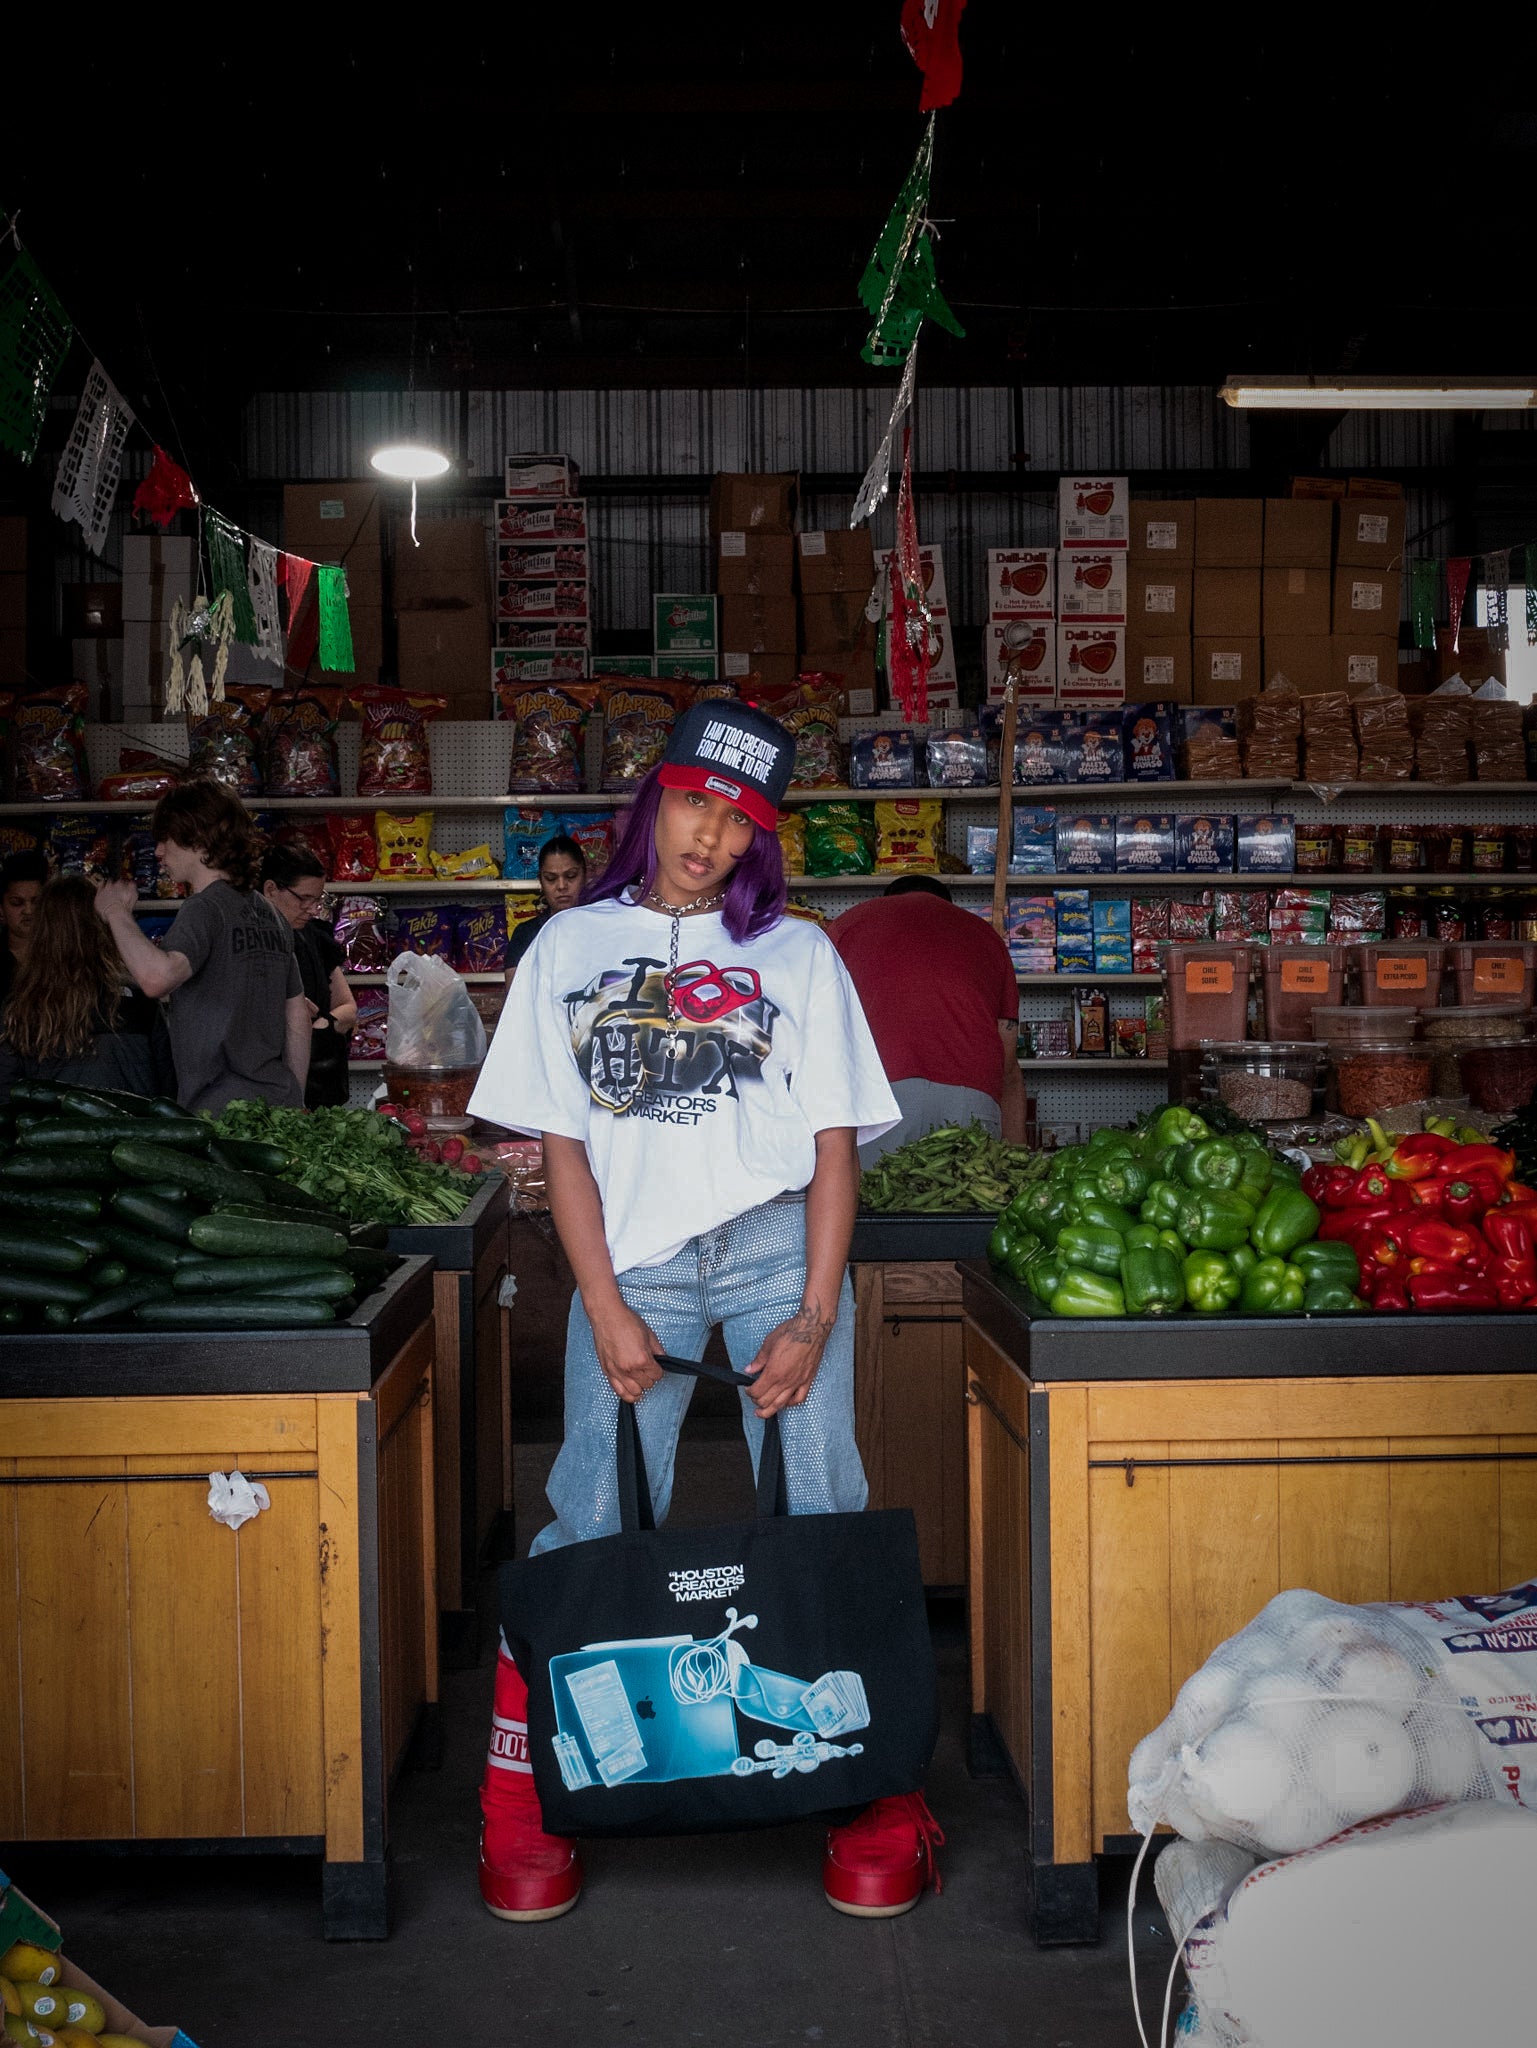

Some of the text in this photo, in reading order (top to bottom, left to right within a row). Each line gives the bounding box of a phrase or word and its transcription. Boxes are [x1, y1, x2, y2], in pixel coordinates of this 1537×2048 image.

[515, 694, 564, 721] HAPPY
[550, 707, 578, 725] MIX
[607, 694, 659, 724] HAPPY
[645, 706, 672, 724] MIX
[703, 720, 780, 766] I AM TOO CREATIVE
[695, 738, 772, 784] FOR A NINE TO FIVE
[1132, 761, 1163, 769] PAYASO
[1078, 768, 1112, 776] PAYASO
[1068, 856, 1102, 864] PAYASO
[1128, 856, 1162, 864] PAYASO
[1187, 855, 1221, 864] PAYASO
[407, 914, 438, 935] Takis
[467, 915, 495, 938] Takis
[608, 957, 667, 1010] I
[593, 1024, 750, 1103] HTX
[618, 1089, 717, 1113] CREATORS
[627, 1105, 703, 1126] MARKET
[668, 1574, 746, 1592] CREATORS
